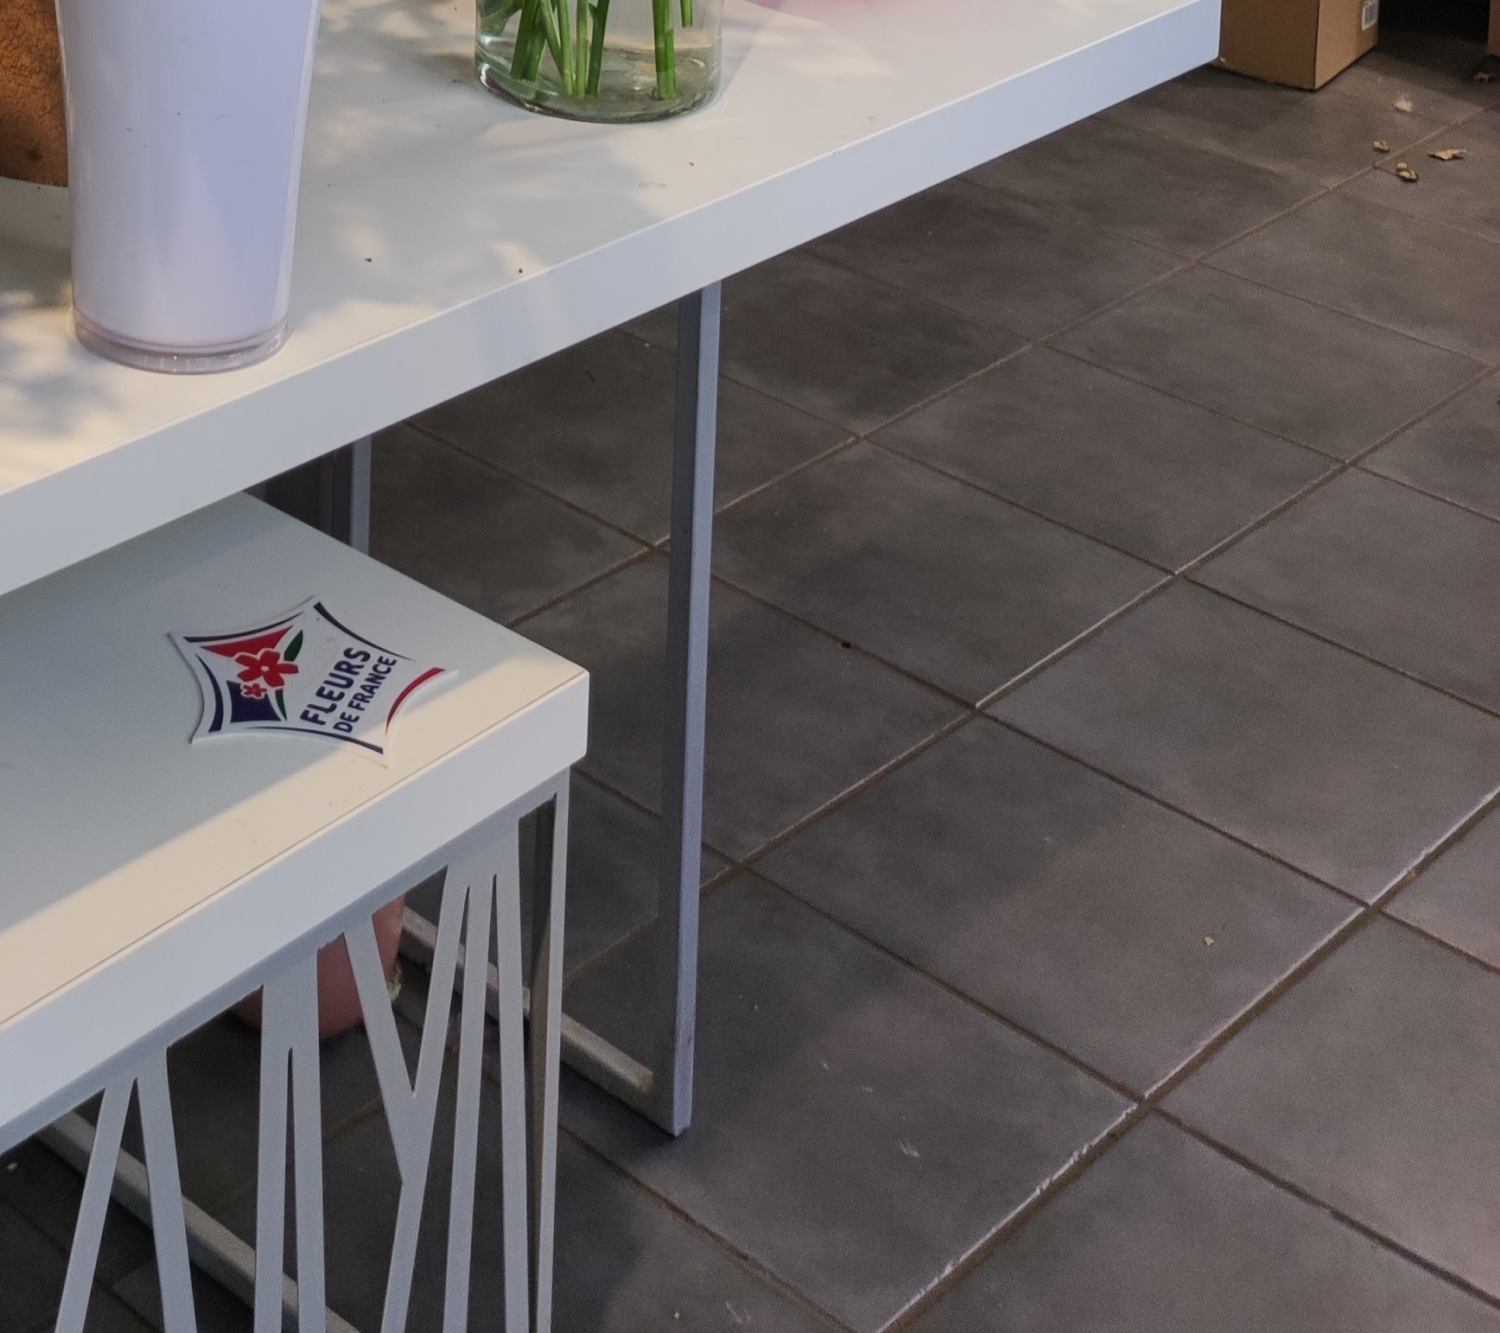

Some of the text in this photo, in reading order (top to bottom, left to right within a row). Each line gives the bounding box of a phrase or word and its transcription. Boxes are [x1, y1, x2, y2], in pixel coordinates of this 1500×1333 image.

[300, 647, 371, 726] FLEURS
[333, 655, 397, 733] DE FRANCE
